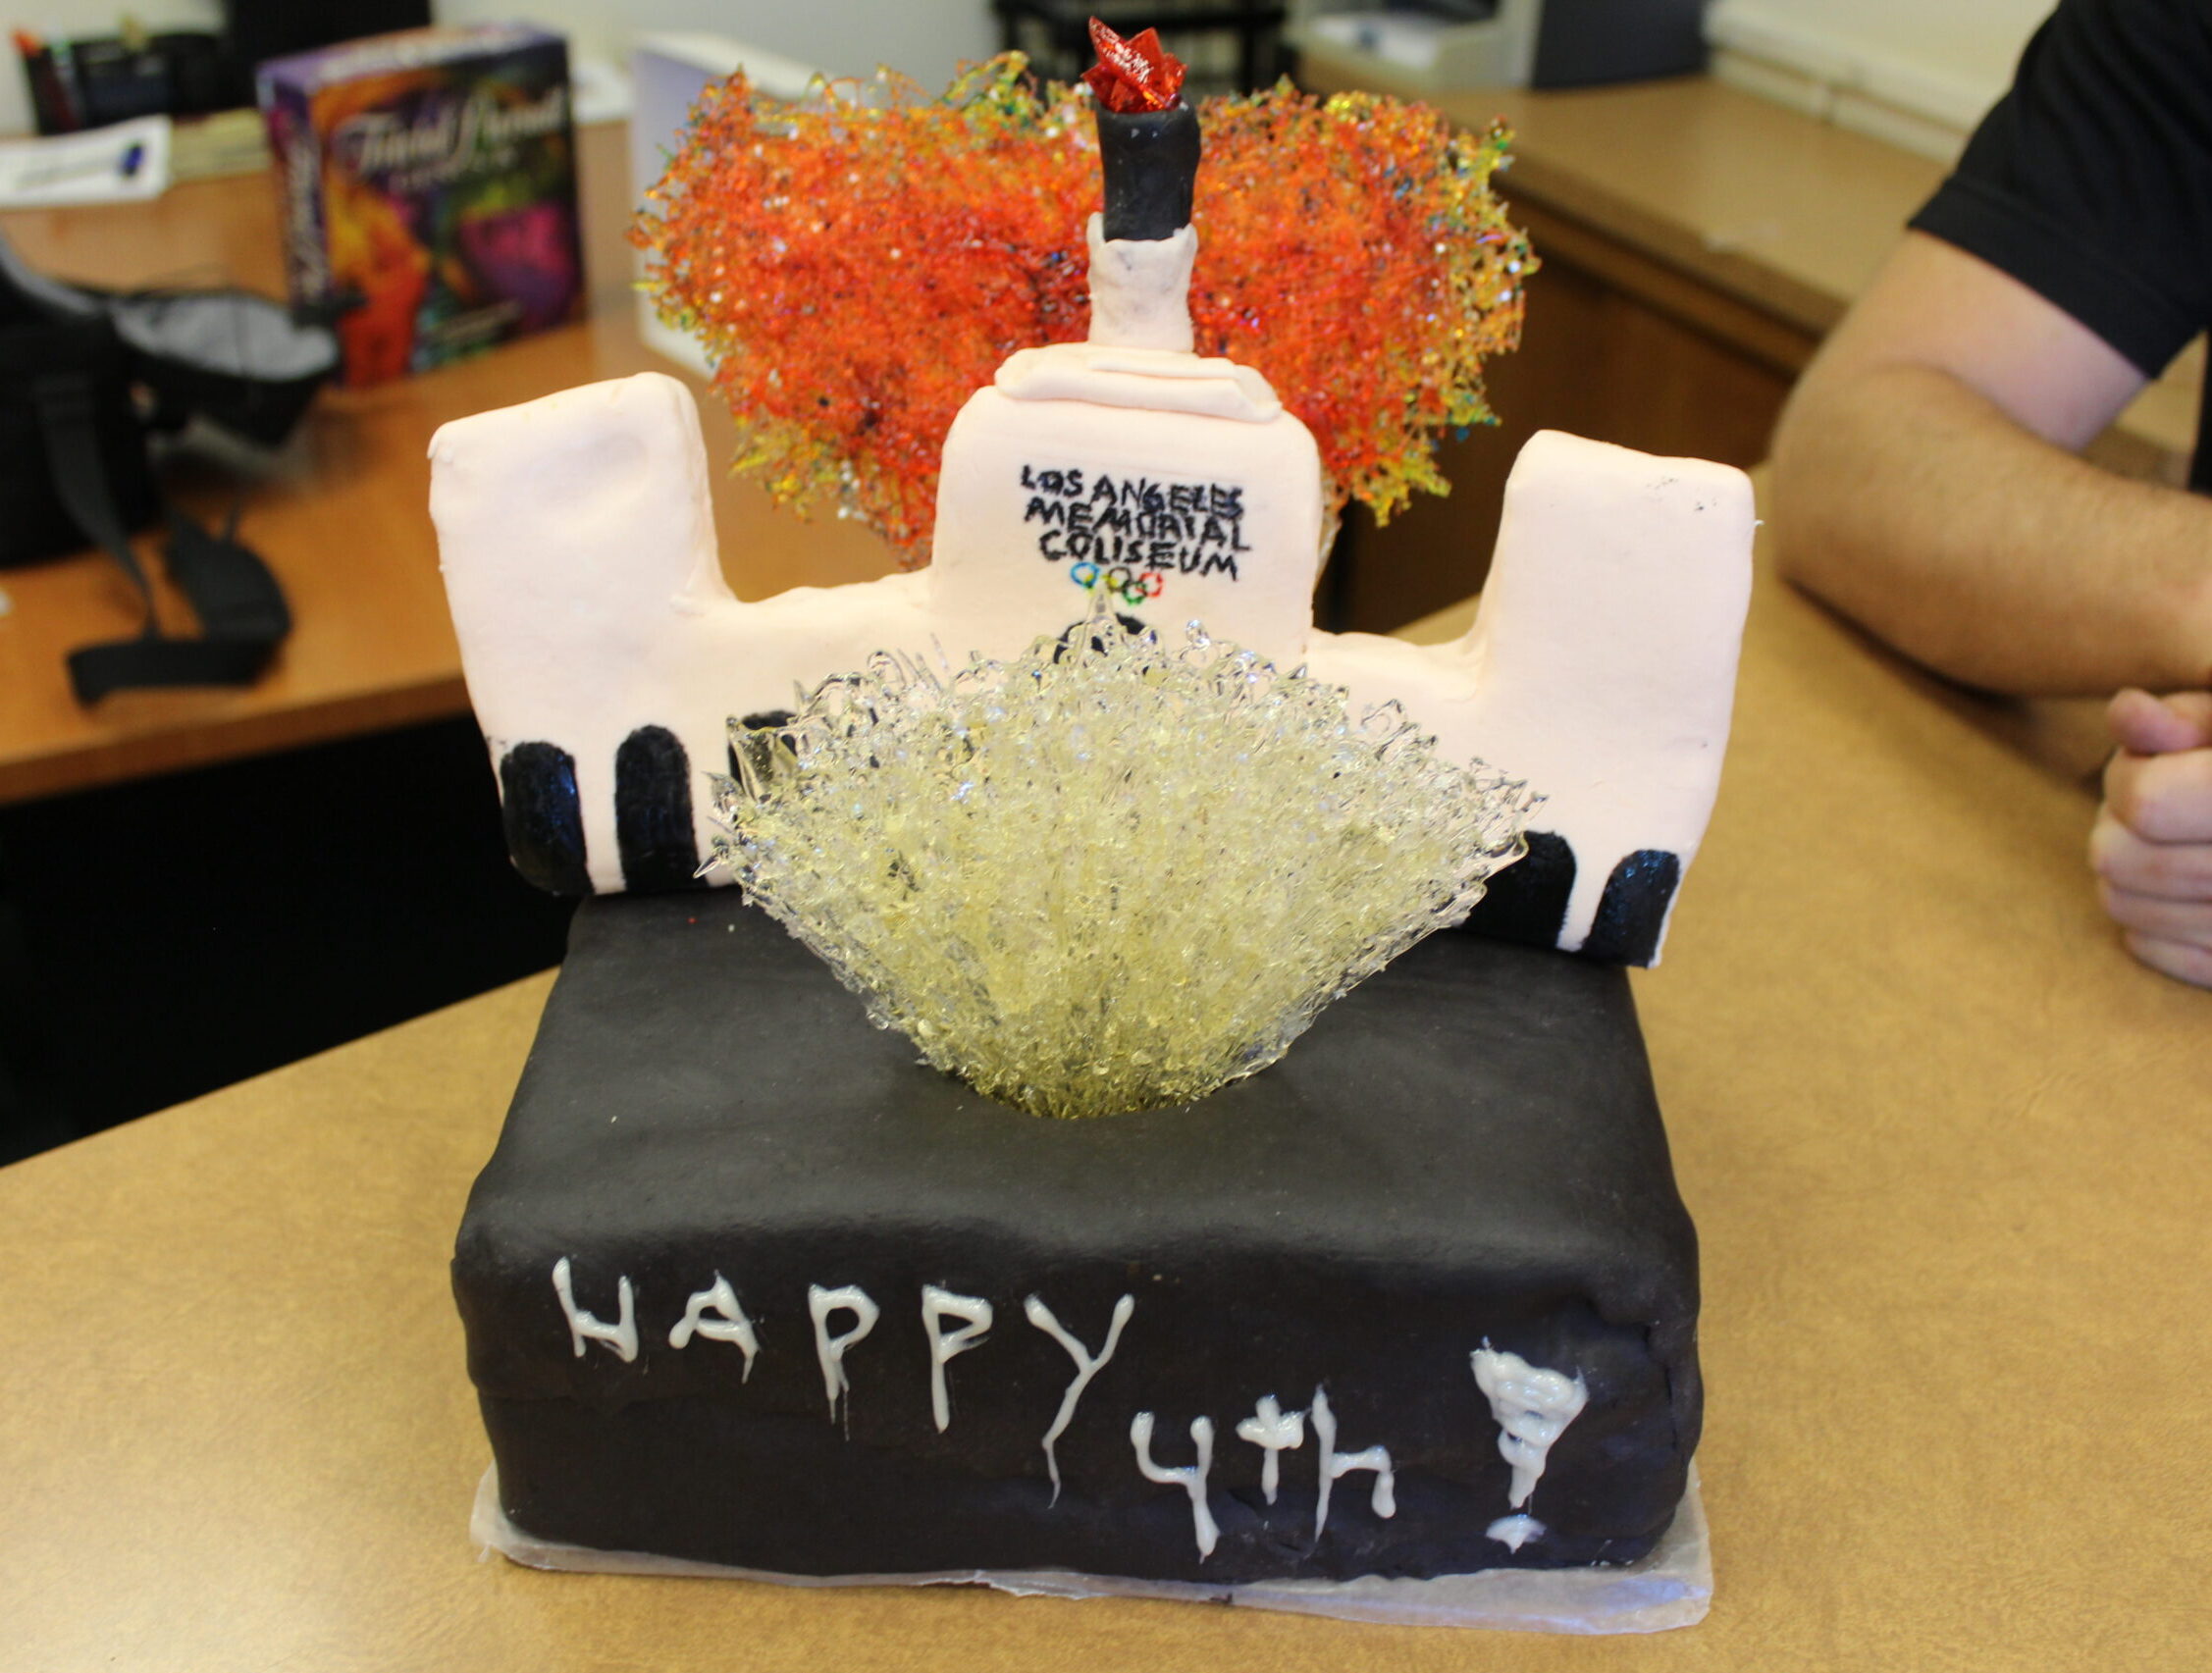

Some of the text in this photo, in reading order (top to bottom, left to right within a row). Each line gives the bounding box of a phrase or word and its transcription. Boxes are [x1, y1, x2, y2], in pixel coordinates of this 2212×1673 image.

[1021, 464, 1244, 520] LOS ANGELES
[1024, 497, 1251, 551] MEMORIAL
[1038, 529, 1238, 581] COLISEUM
[552, 1256, 1134, 1508] HAPPY
